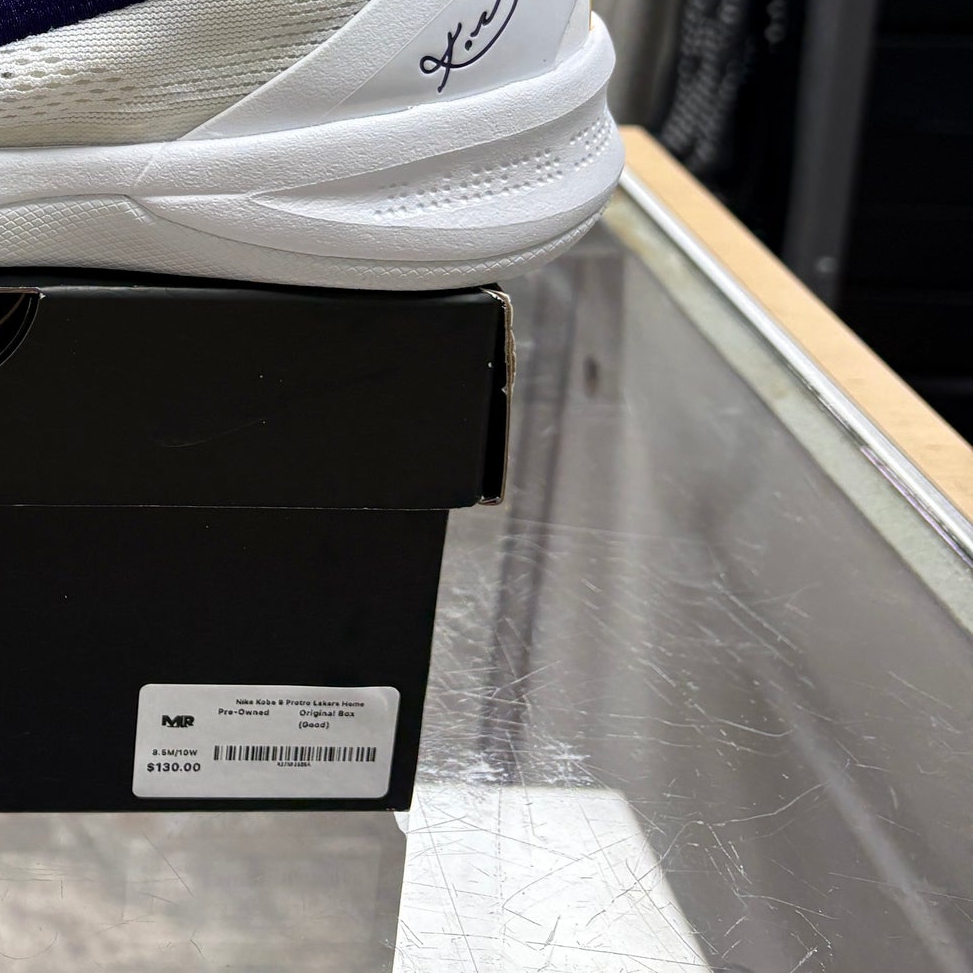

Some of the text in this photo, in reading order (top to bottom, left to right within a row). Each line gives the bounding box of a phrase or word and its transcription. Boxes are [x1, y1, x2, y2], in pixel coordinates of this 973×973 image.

[235, 698, 254, 706] Nike
[299, 709, 335, 718] Original
[298, 721, 330, 729] (Good)
[147, 762, 201, 773] $130.00
